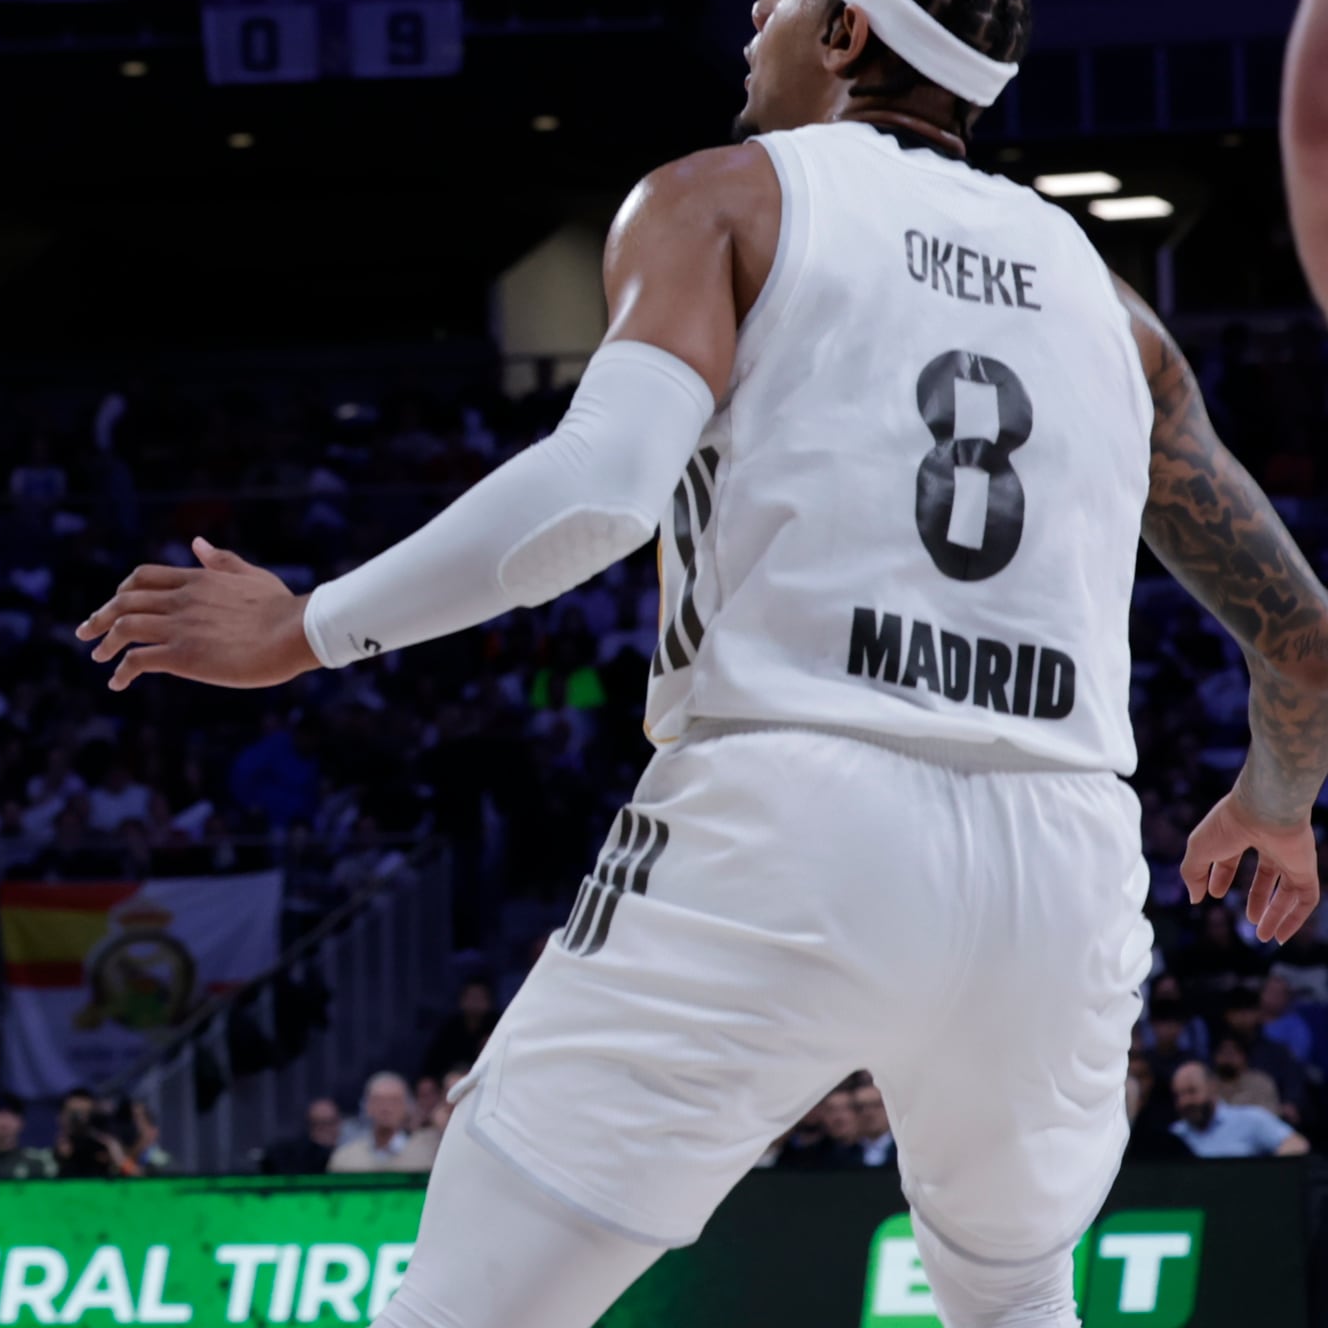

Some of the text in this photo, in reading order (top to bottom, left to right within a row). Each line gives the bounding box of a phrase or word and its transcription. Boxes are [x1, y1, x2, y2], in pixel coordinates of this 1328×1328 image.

[904, 229, 1042, 311] OKEKE
[915, 349, 1033, 582] 8
[847, 606, 1076, 720] MADRID
